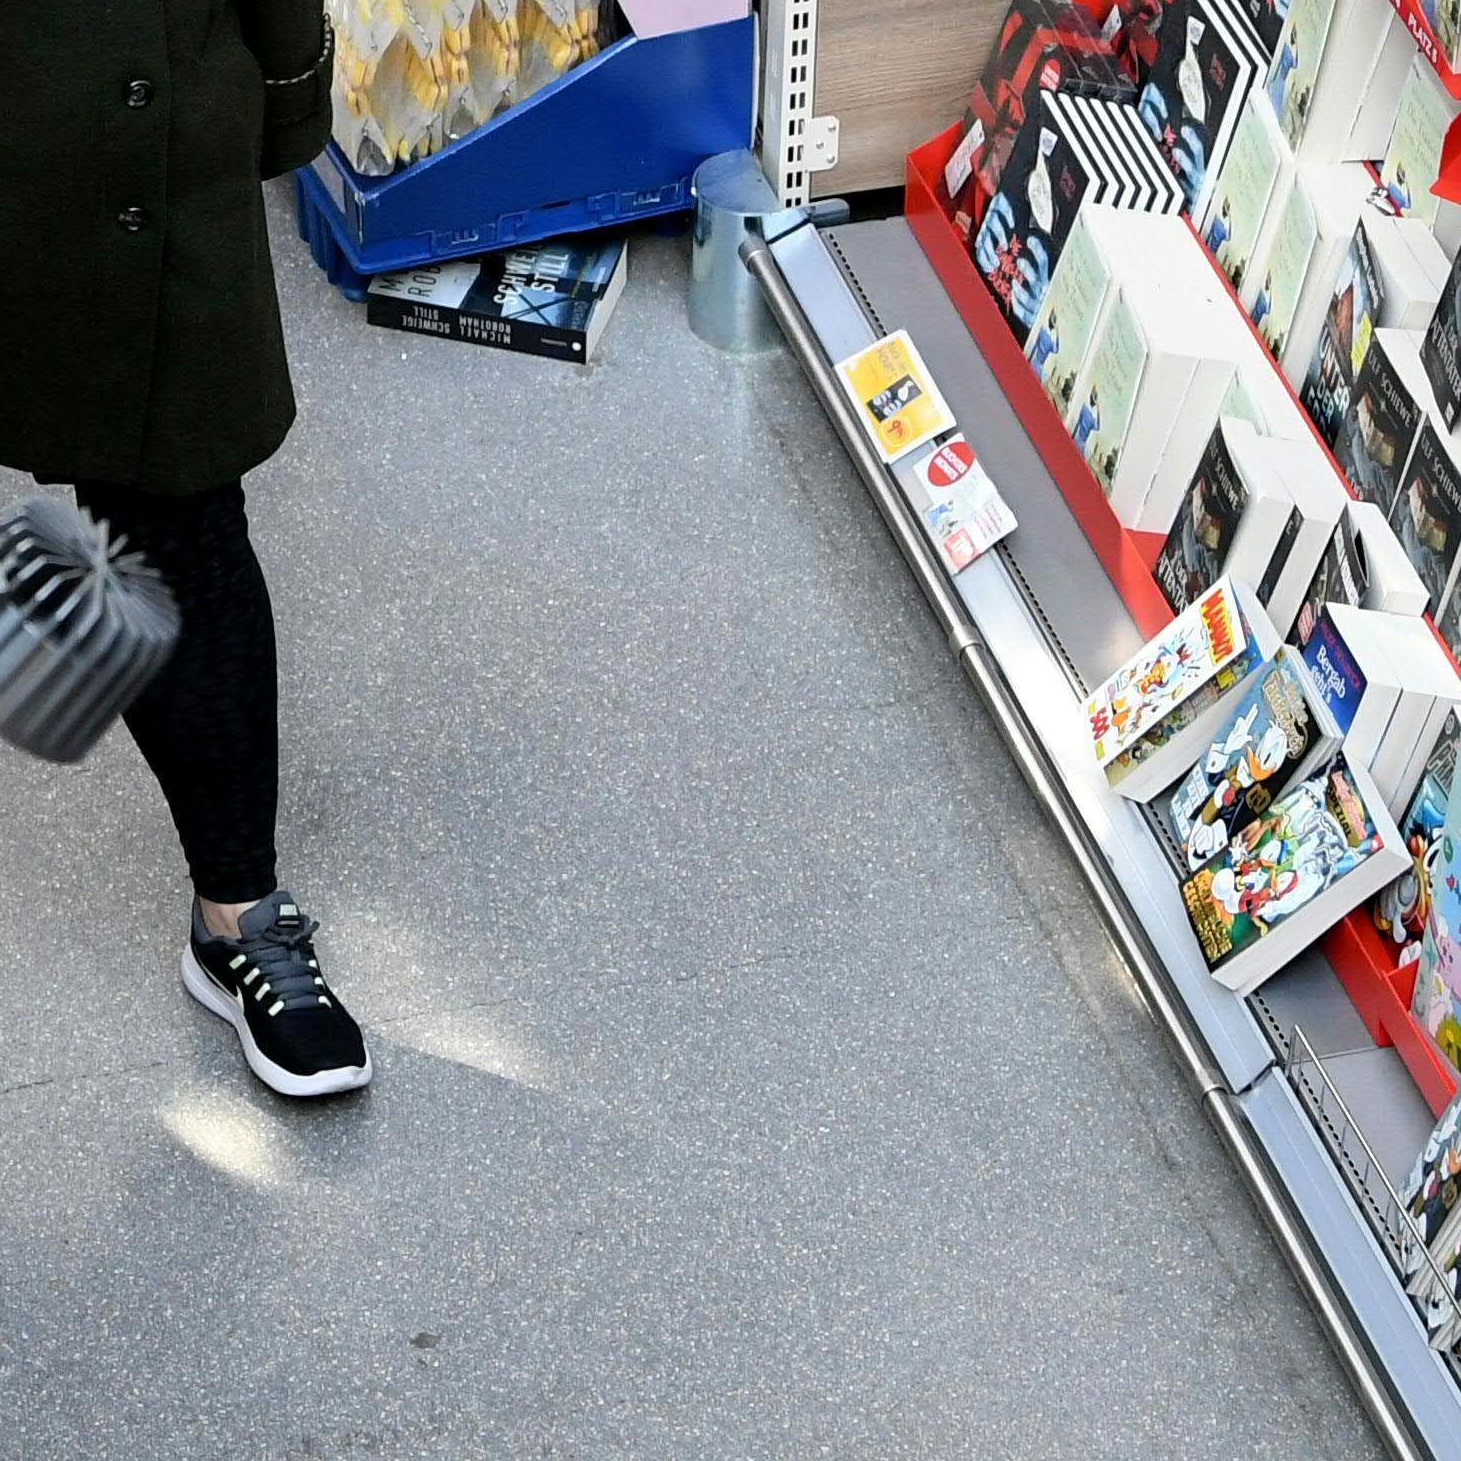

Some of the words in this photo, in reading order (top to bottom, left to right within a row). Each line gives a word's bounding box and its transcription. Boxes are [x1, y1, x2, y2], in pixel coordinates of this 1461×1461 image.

[1407, 11, 1433, 56] PLATZ
[493, 249, 538, 306] SCHWEI
[530, 253, 569, 293] STILL
[401, 314, 451, 335] SCHWEIGE
[412, 305, 440, 321] STILL
[458, 314, 512, 333] ROBOTHAM
[459, 326, 512, 345] MICHAEL
[1317, 323, 1351, 421] UNTER
[1367, 348, 1382, 379] ULF
[1379, 373, 1414, 429] SCHIEWE
[1419, 432, 1434, 463] ULF
[1214, 459, 1240, 512] SCHIEWE
[1316, 643, 1346, 699] Bergab
[1327, 786, 1352, 839] SPEZIAL
